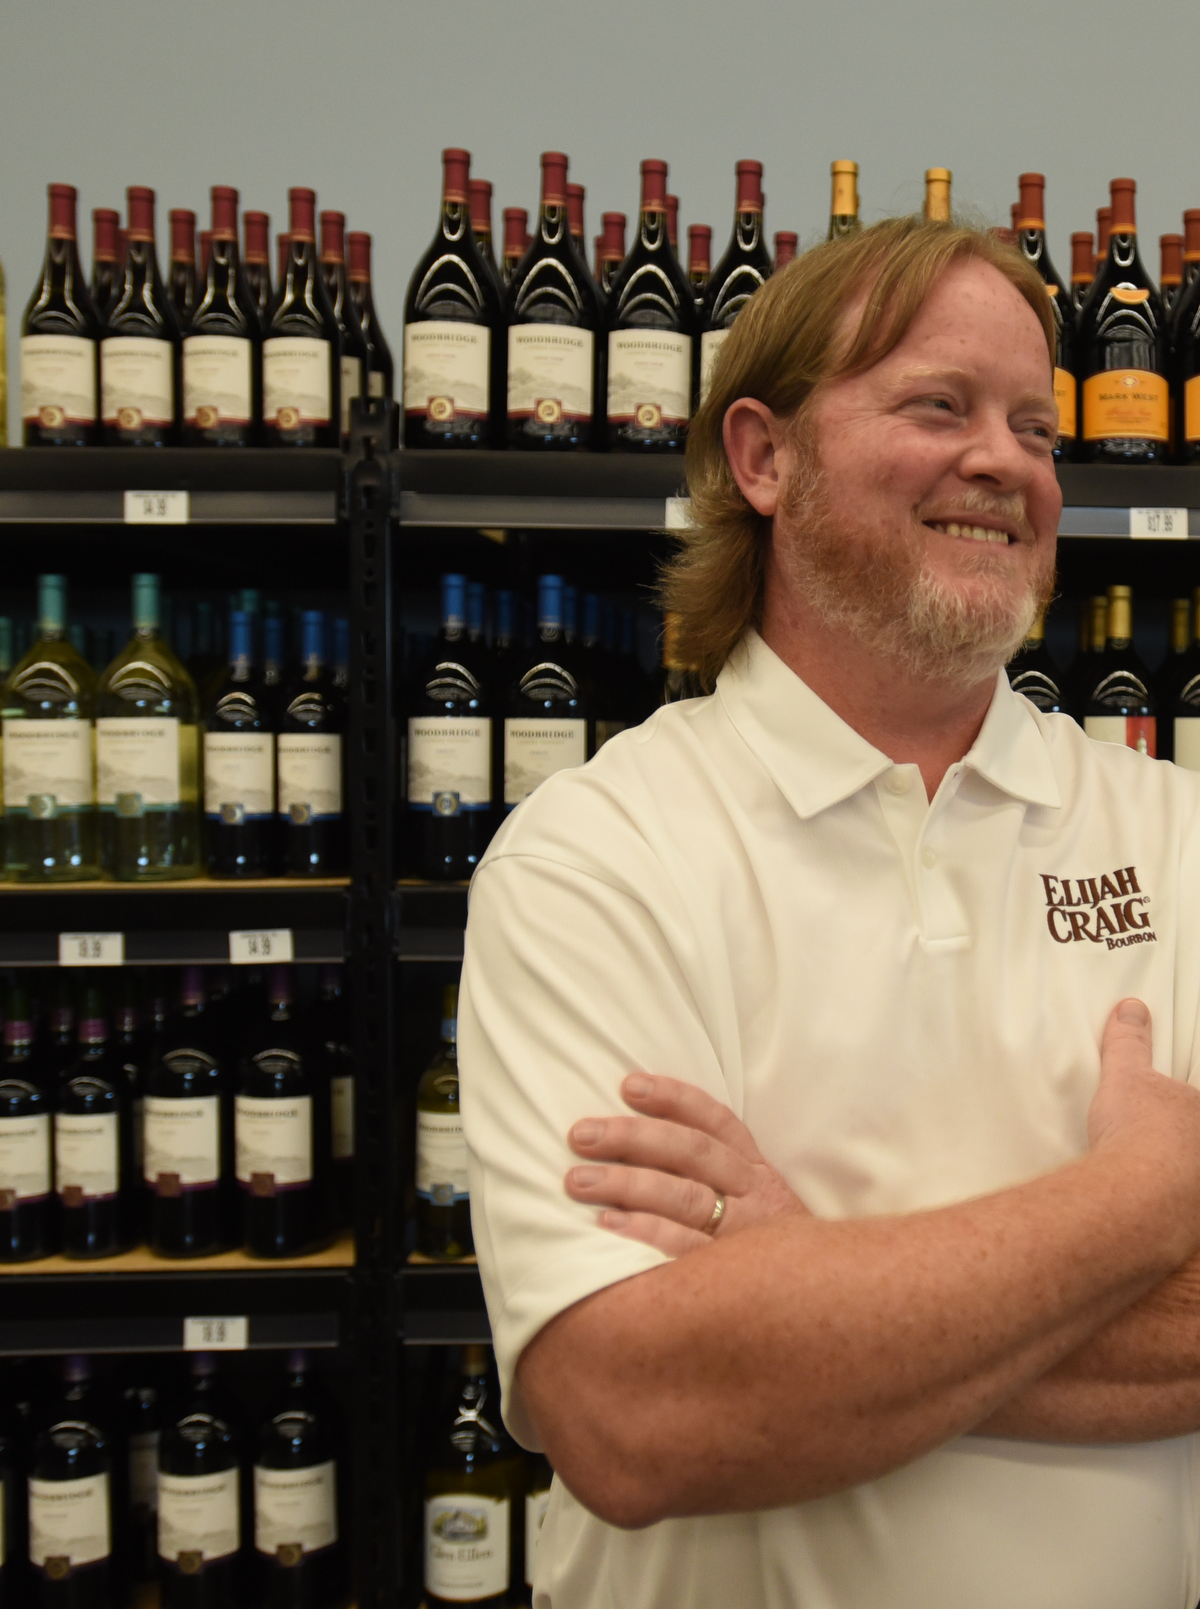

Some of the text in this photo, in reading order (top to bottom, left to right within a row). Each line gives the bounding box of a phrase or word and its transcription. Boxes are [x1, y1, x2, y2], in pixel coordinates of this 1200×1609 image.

[410, 333, 478, 344] WOODBRIDGE
[515, 335, 584, 348] WOODBRIDGE
[616, 341, 683, 353] WOODBRIDGE
[1098, 392, 1159, 402] MARK WEST
[414, 728, 481, 737] WOODBRIDGE
[509, 729, 575, 739] WOODBRIDGE
[1039, 866, 1141, 909] ELIJAH
[1047, 898, 1151, 943] CRAIG
[1105, 932, 1157, 950] BOURBON
